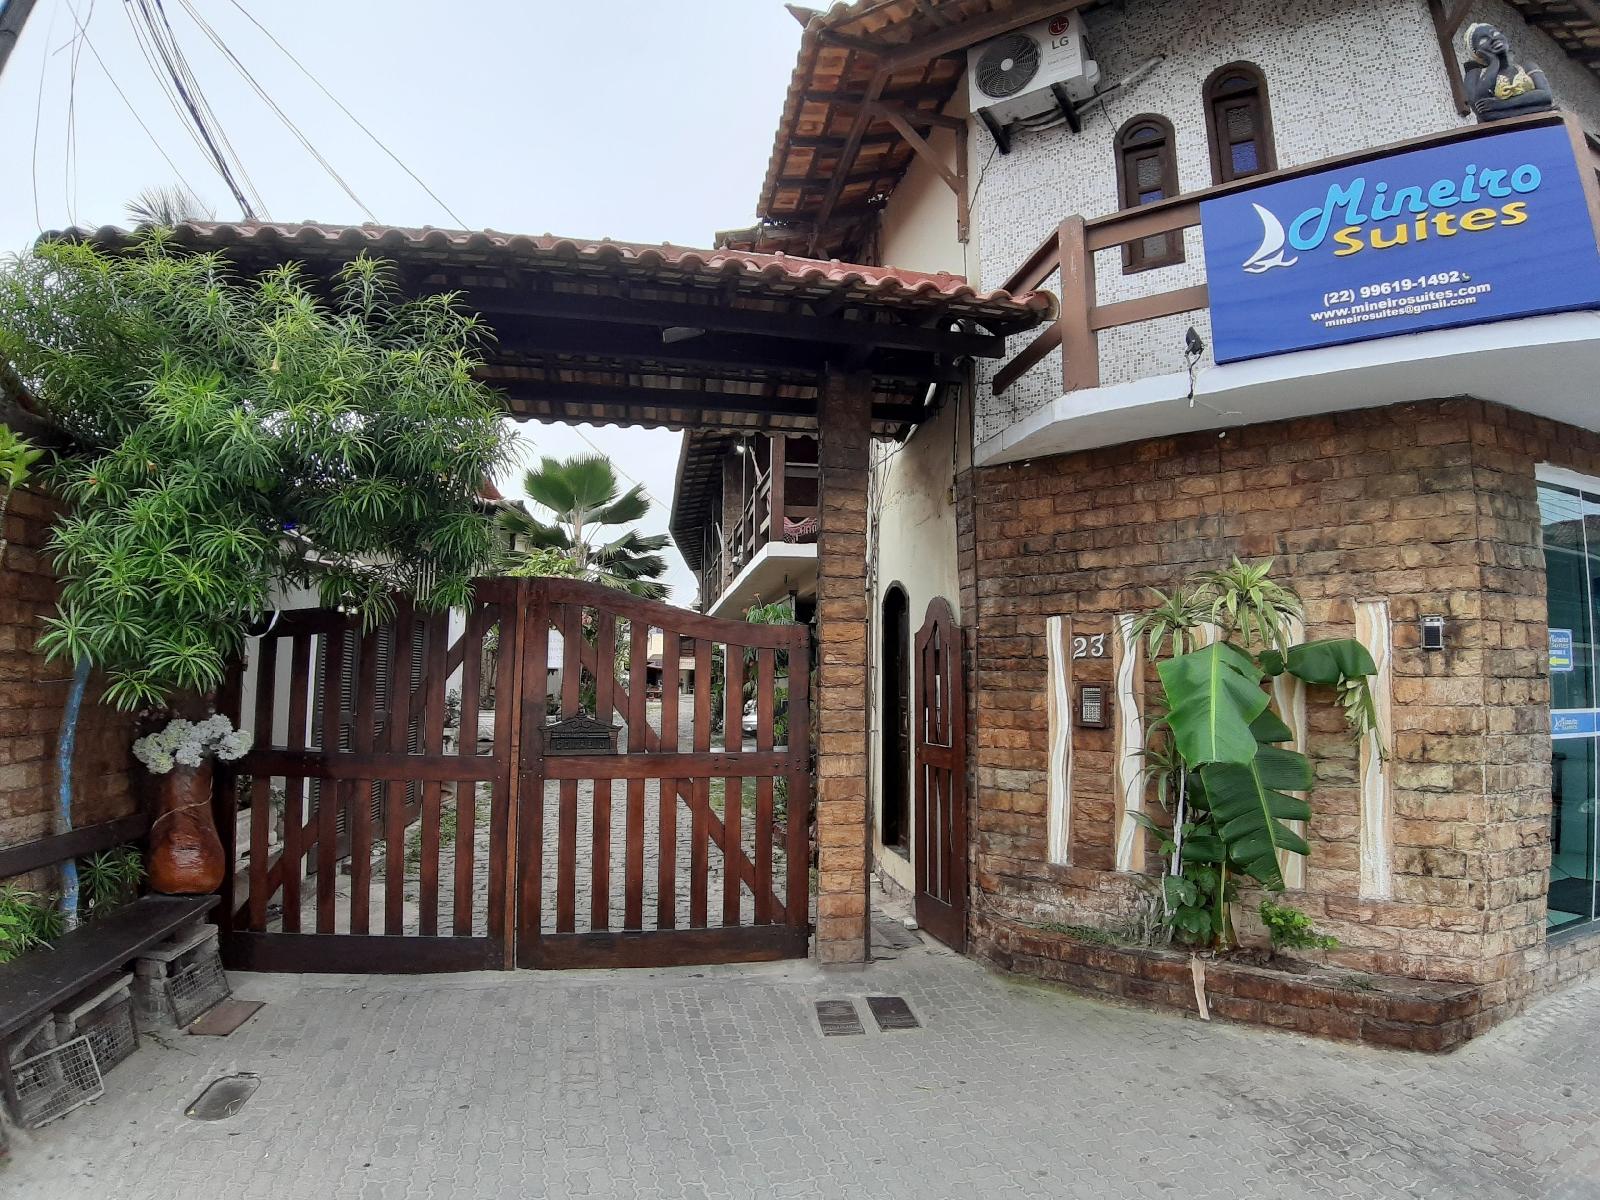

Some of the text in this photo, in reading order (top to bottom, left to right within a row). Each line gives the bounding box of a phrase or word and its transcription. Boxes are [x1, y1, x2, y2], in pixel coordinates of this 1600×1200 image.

[1052, 36, 1069, 49] LG
[1288, 163, 1542, 251] Mineiro
[1310, 282, 1492, 322] www.mineirosuites.com
[1323, 270, 1461, 307] (22) 99619-1492
[1324, 295, 1477, 328] mineirosuites@gmail.com
[1073, 632, 1105, 660] 23
